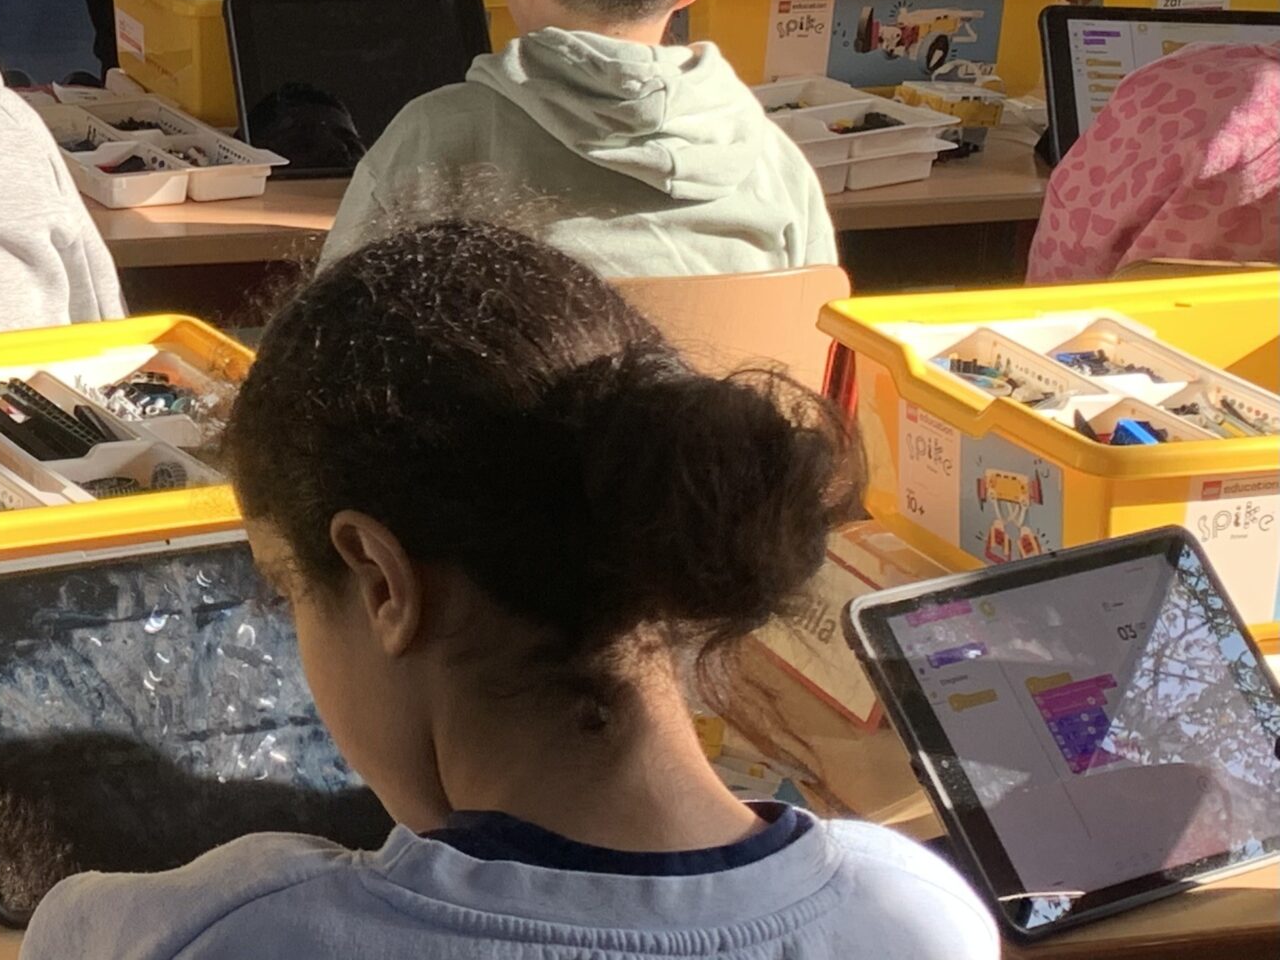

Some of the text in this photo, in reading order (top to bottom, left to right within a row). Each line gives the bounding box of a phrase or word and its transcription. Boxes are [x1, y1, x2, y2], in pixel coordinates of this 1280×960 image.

[776, 14, 825, 39] spike
[905, 432, 953, 477] spike
[1223, 480, 1279, 495] education
[906, 494, 926, 516] 10+
[1197, 500, 1275, 543] spike
